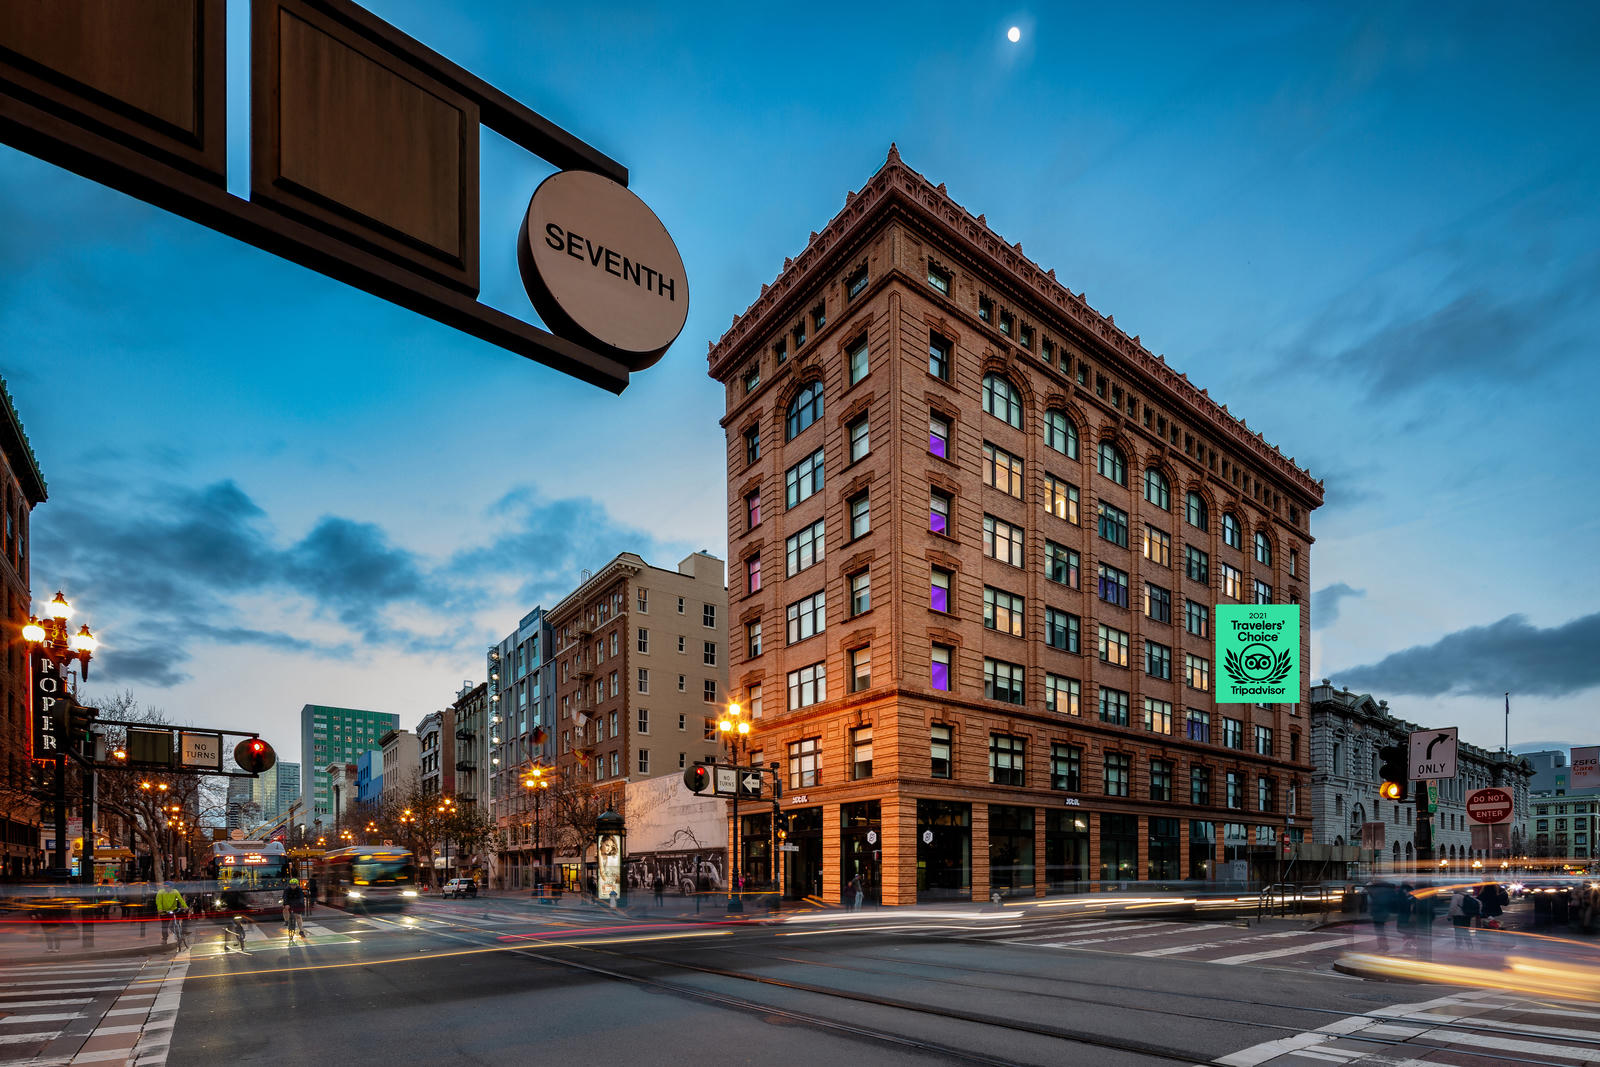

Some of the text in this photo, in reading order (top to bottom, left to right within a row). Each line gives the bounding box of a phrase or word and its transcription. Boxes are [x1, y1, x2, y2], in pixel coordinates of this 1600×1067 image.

[545, 223, 675, 301] SEVENTH
[194, 743, 207, 751] NO
[185, 751, 216, 759] TURNS
[1418, 763, 1446, 774] ONLY
[1488, 794, 1505, 802] NOT
[1476, 810, 1504, 818] ENTER
[224, 855, 235, 864] 21
